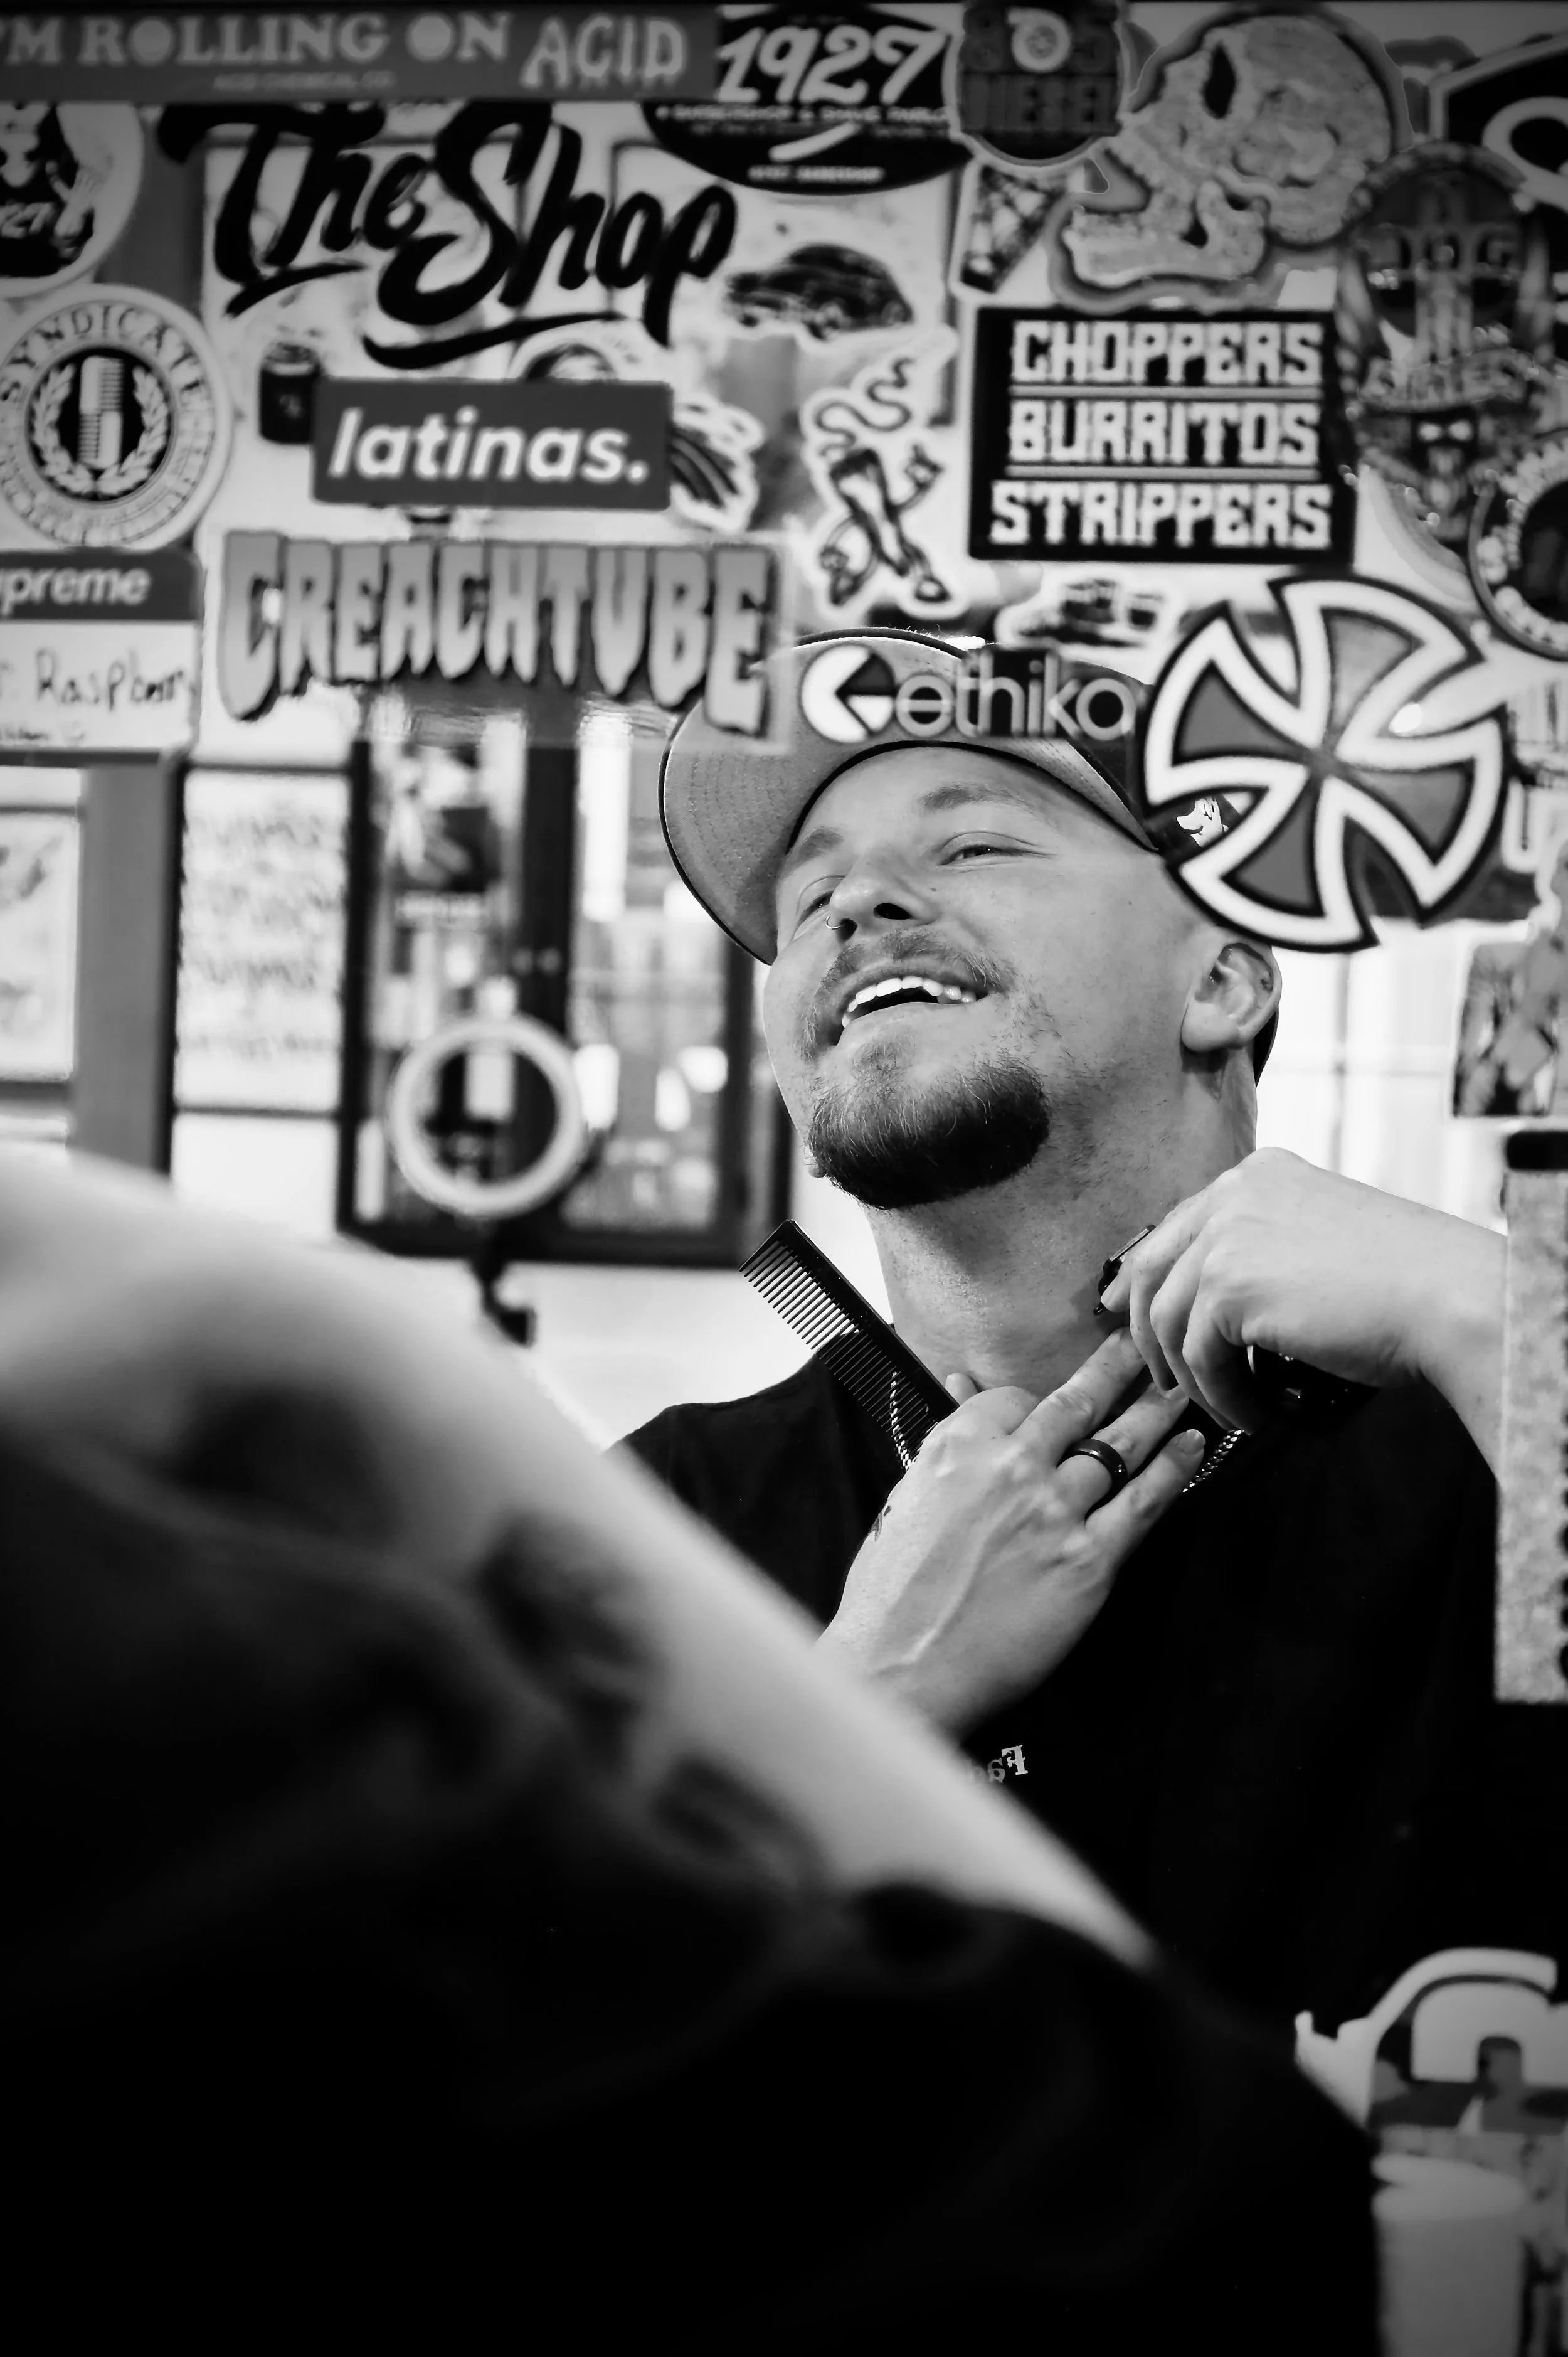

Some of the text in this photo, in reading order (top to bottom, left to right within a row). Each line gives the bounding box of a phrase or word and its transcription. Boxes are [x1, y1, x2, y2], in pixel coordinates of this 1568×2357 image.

[80, 14, 391, 64] ROLLING
[404, 13, 511, 61] ON
[519, 14, 689, 88] ACID
[716, 24, 951, 105] 1927
[157, 101, 736, 349] The Shop
[1010, 320, 1325, 385] CHOPPERS
[327, 407, 650, 481] latinas.
[1009, 400, 1319, 465] BURRITOS
[989, 479, 1332, 550] STRIPPERS
[0, 567, 151, 617] preme
[216, 530, 774, 739] CREACHTUBE
[894, 647, 1136, 739] ethika
